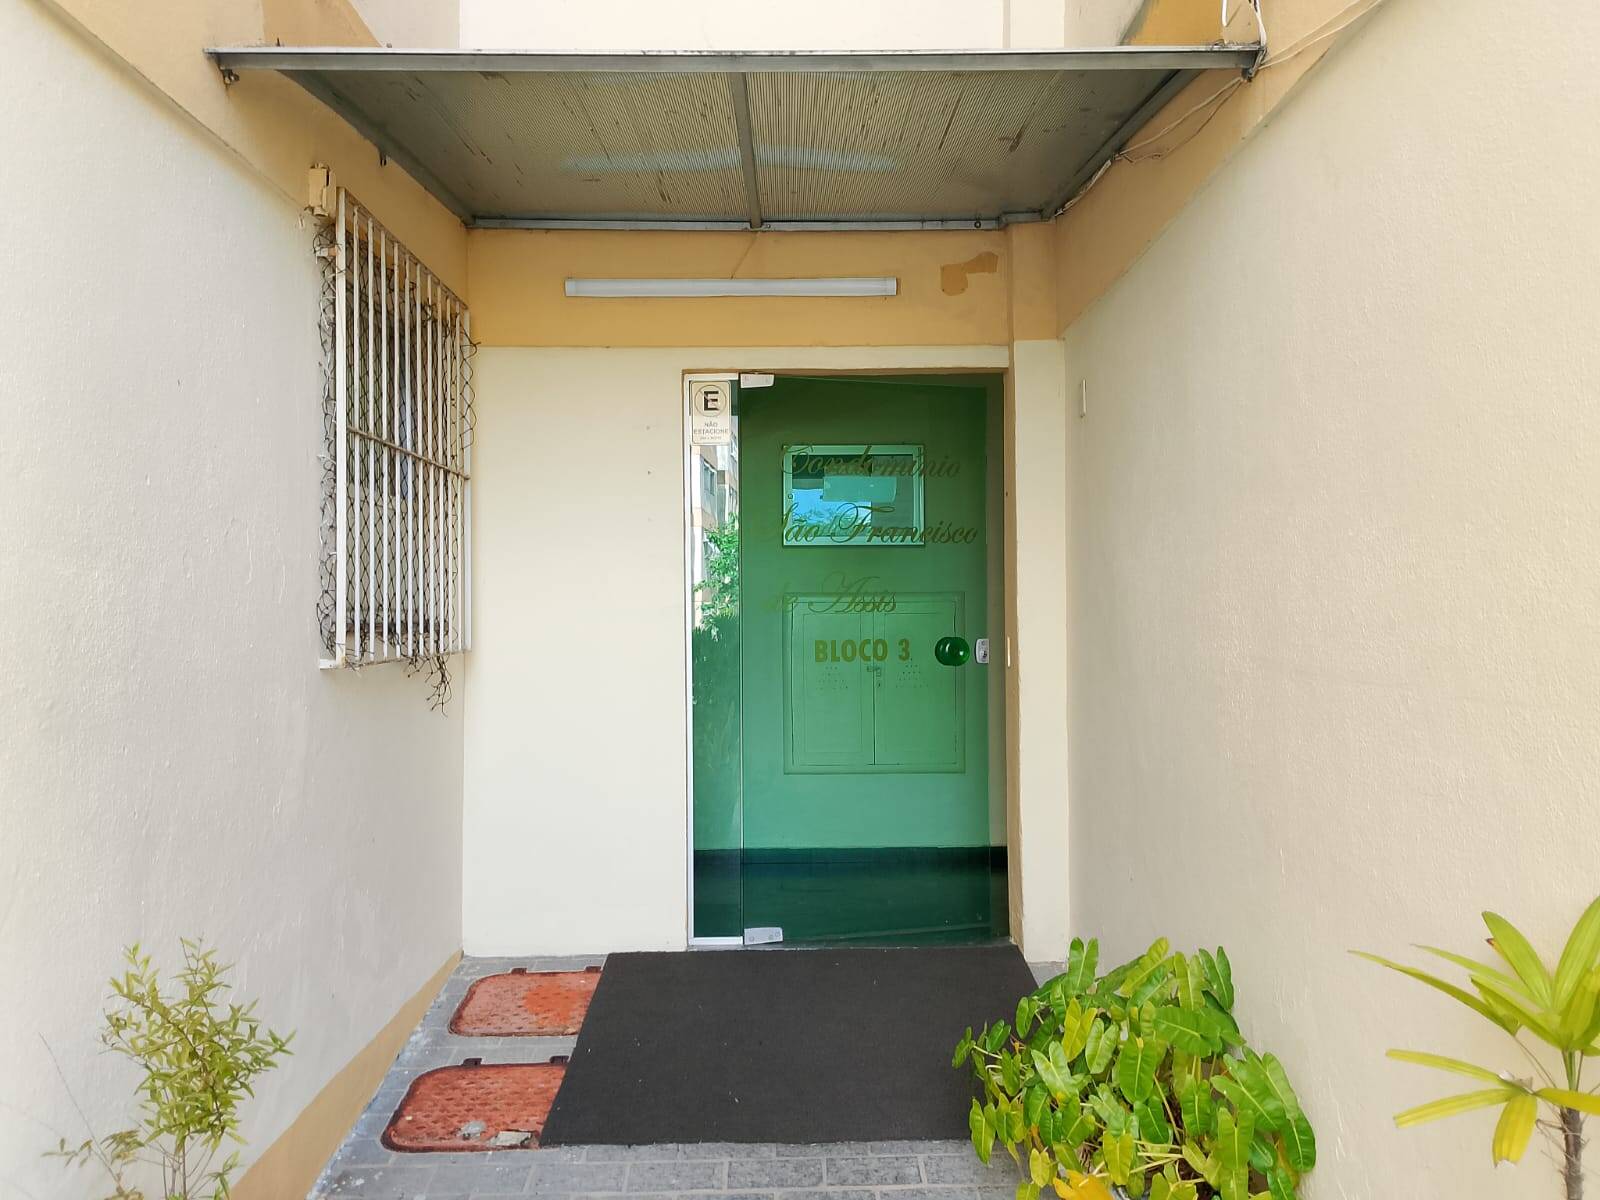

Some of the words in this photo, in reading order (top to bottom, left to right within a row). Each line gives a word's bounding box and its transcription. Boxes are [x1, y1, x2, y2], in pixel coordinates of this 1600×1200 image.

[703, 391, 719, 411] E
[831, 502, 978, 543] Francisco
[814, 638, 888, 663] BLOCO
[898, 638, 910, 661] 3
